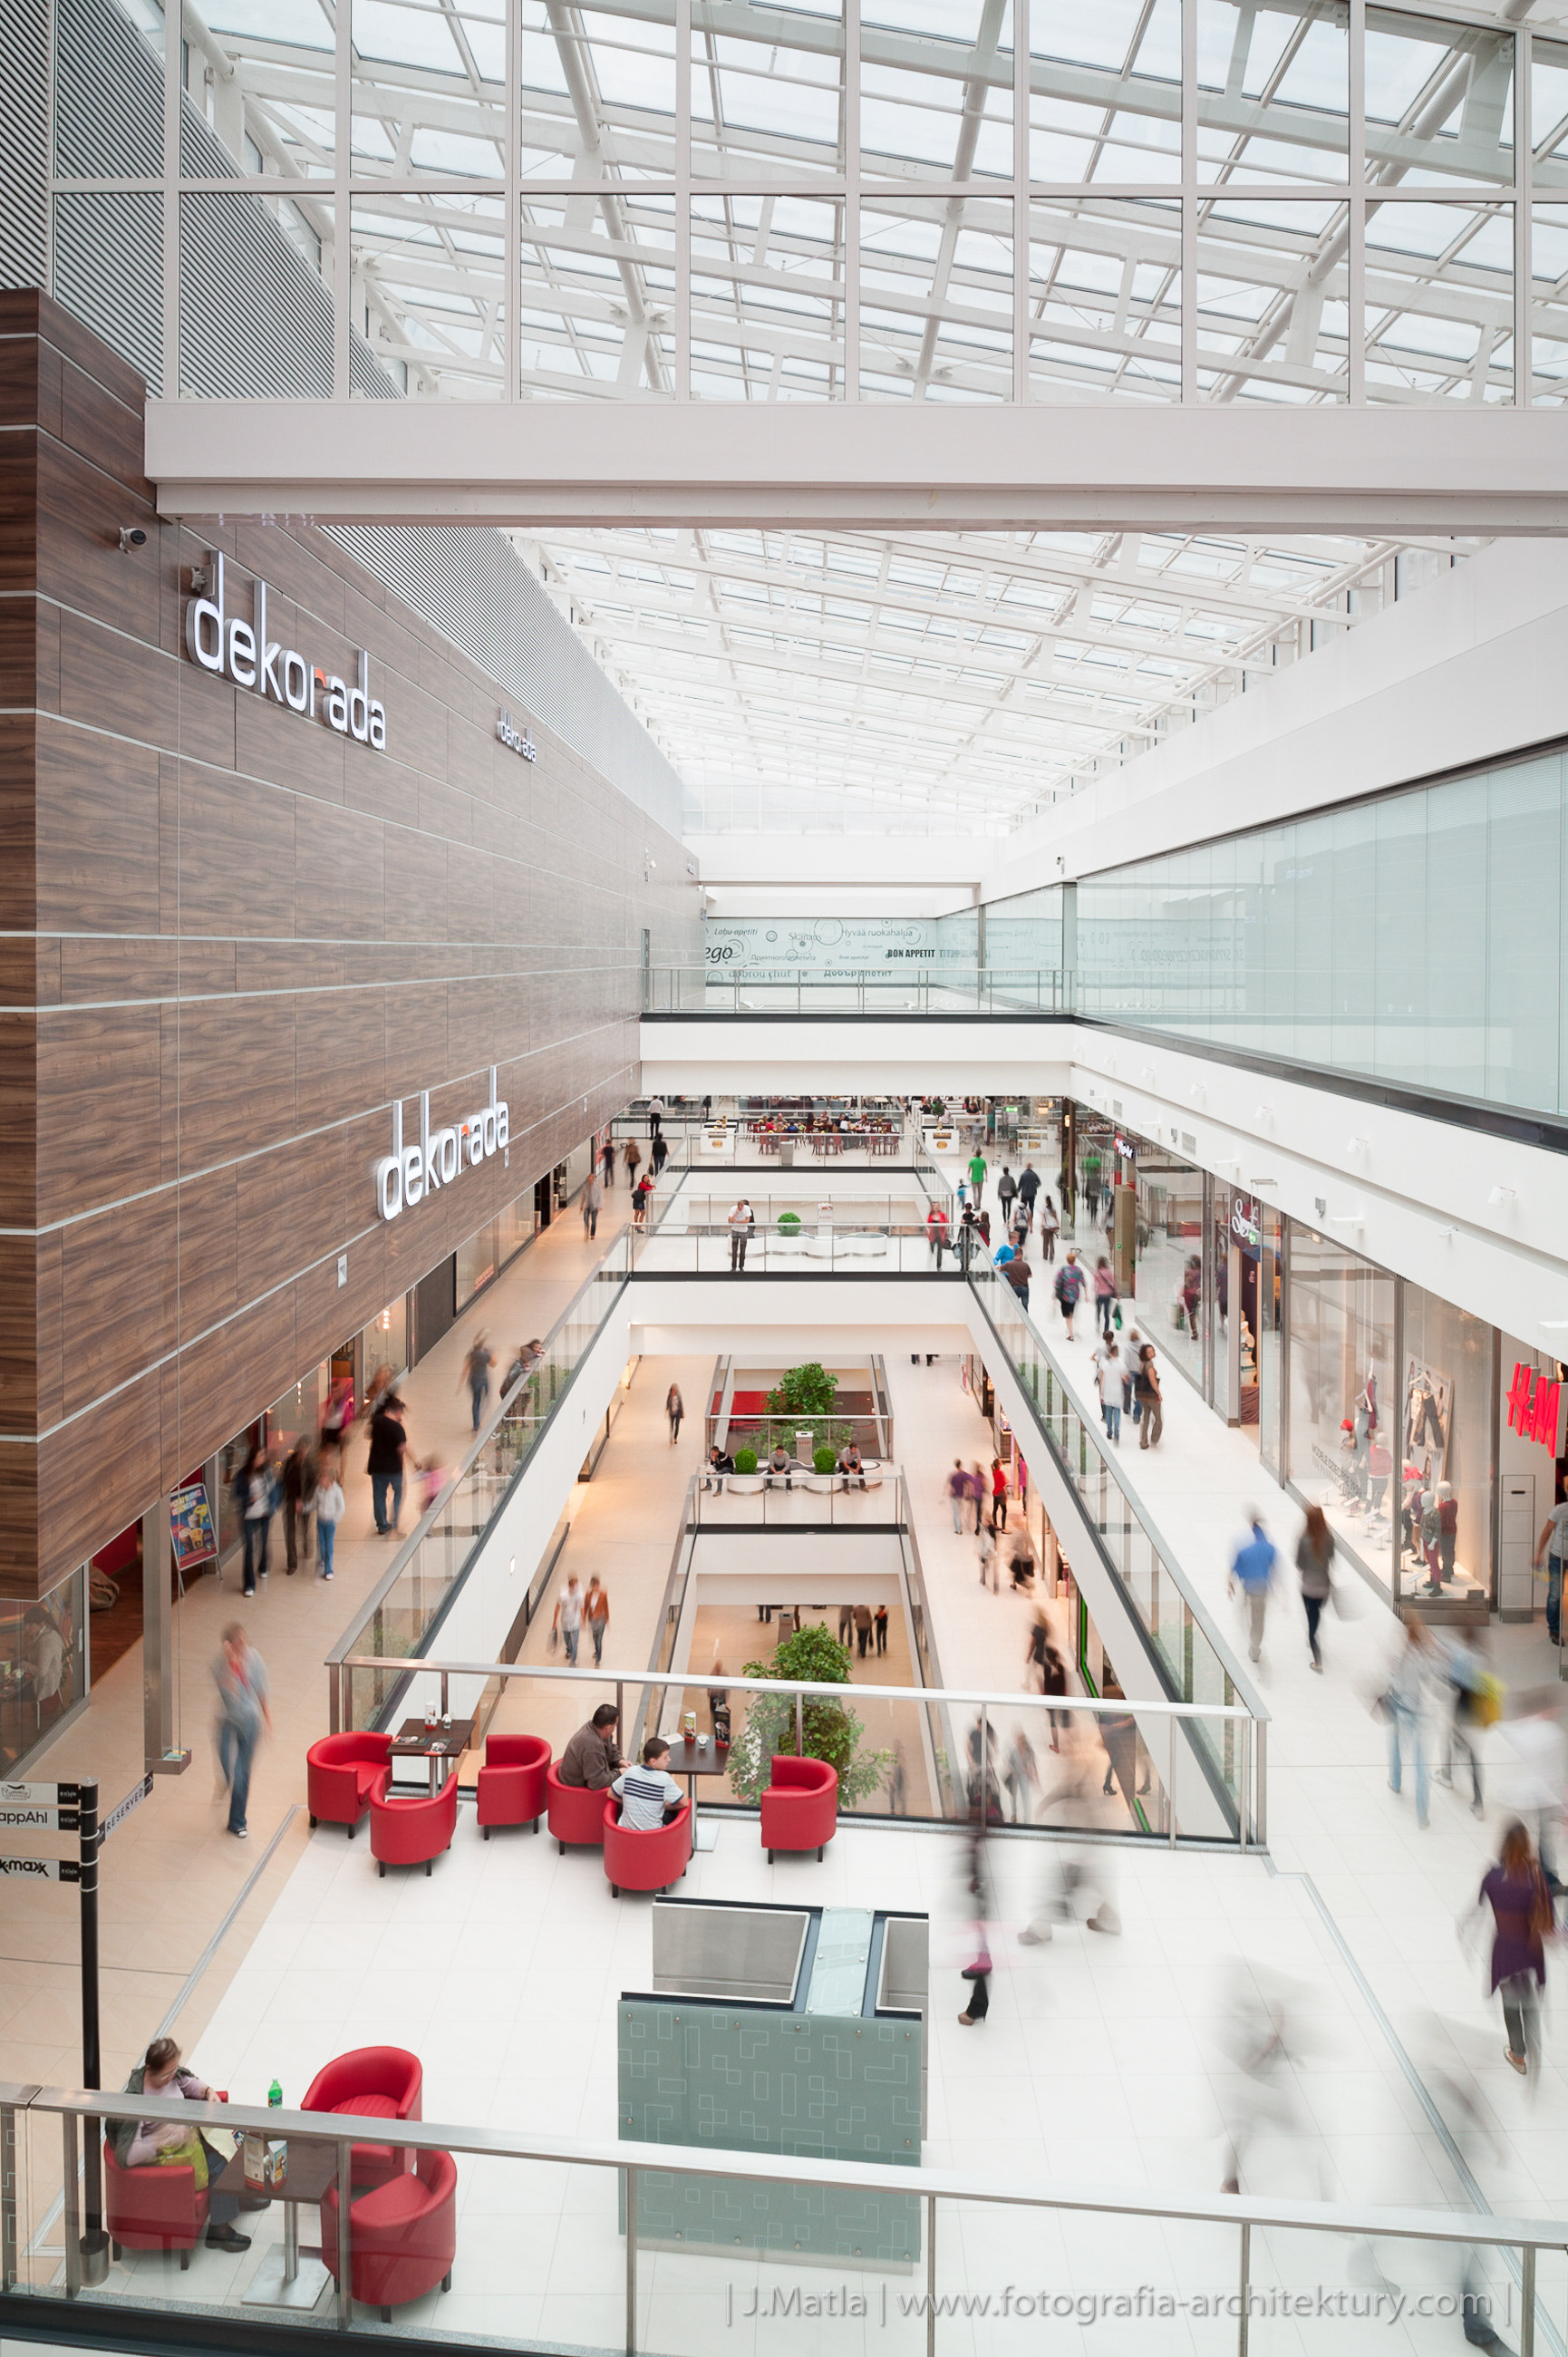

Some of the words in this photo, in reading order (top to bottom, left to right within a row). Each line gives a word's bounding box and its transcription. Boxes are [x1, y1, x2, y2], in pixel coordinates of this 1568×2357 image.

[186, 549, 386, 751] dekorada
[887, 949, 904, 958] BON
[905, 949, 935, 958] APPETIT
[376, 1065, 510, 1221] dekorada
[106, 1788, 144, 1833] RESERVED
